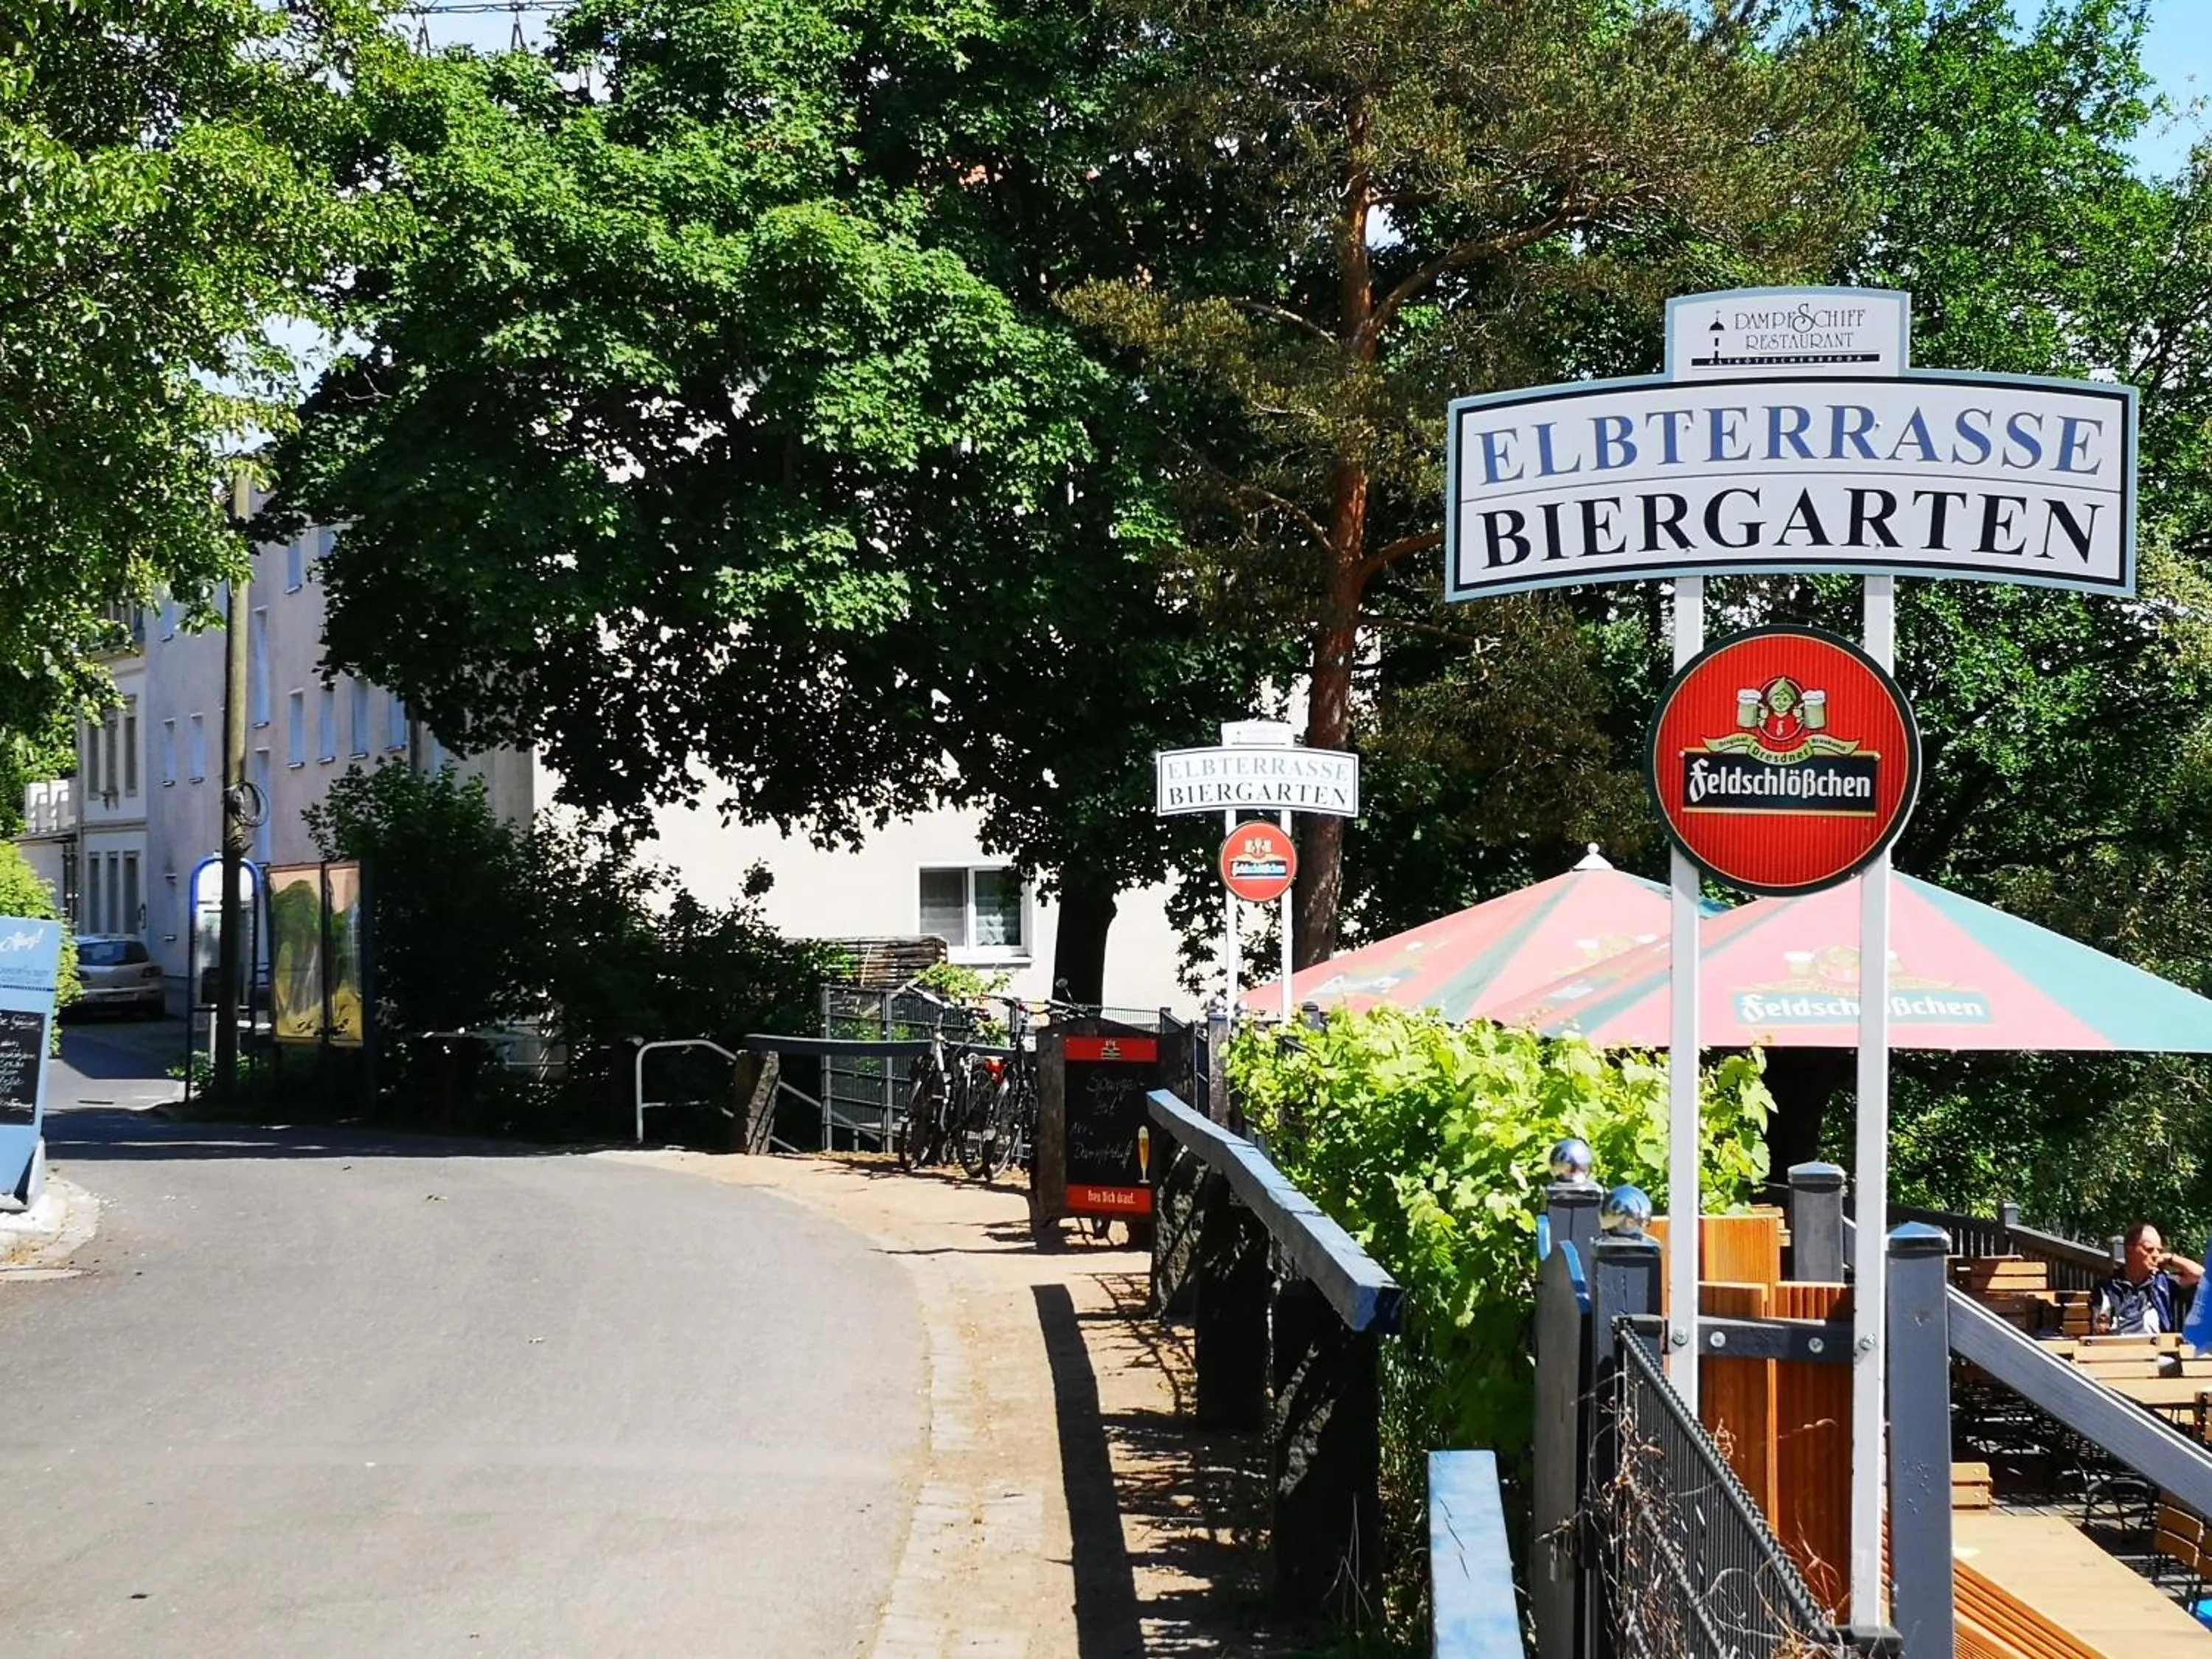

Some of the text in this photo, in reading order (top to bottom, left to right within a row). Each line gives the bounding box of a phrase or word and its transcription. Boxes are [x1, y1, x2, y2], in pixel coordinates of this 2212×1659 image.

[1746, 333, 1854, 349] RESTAURANT
[1475, 404, 2103, 487] ELBTERRASSE
[1478, 487, 2104, 569] BIERGARTEN
[1751, 748, 1809, 762] Dresdner
[1168, 756, 1349, 782] ELBTERRASSE
[1689, 759, 1870, 802] Feldschlößchen
[1169, 782, 1349, 806] BIERGARTEN
[1741, 995, 1983, 1023] Feldschßchen
